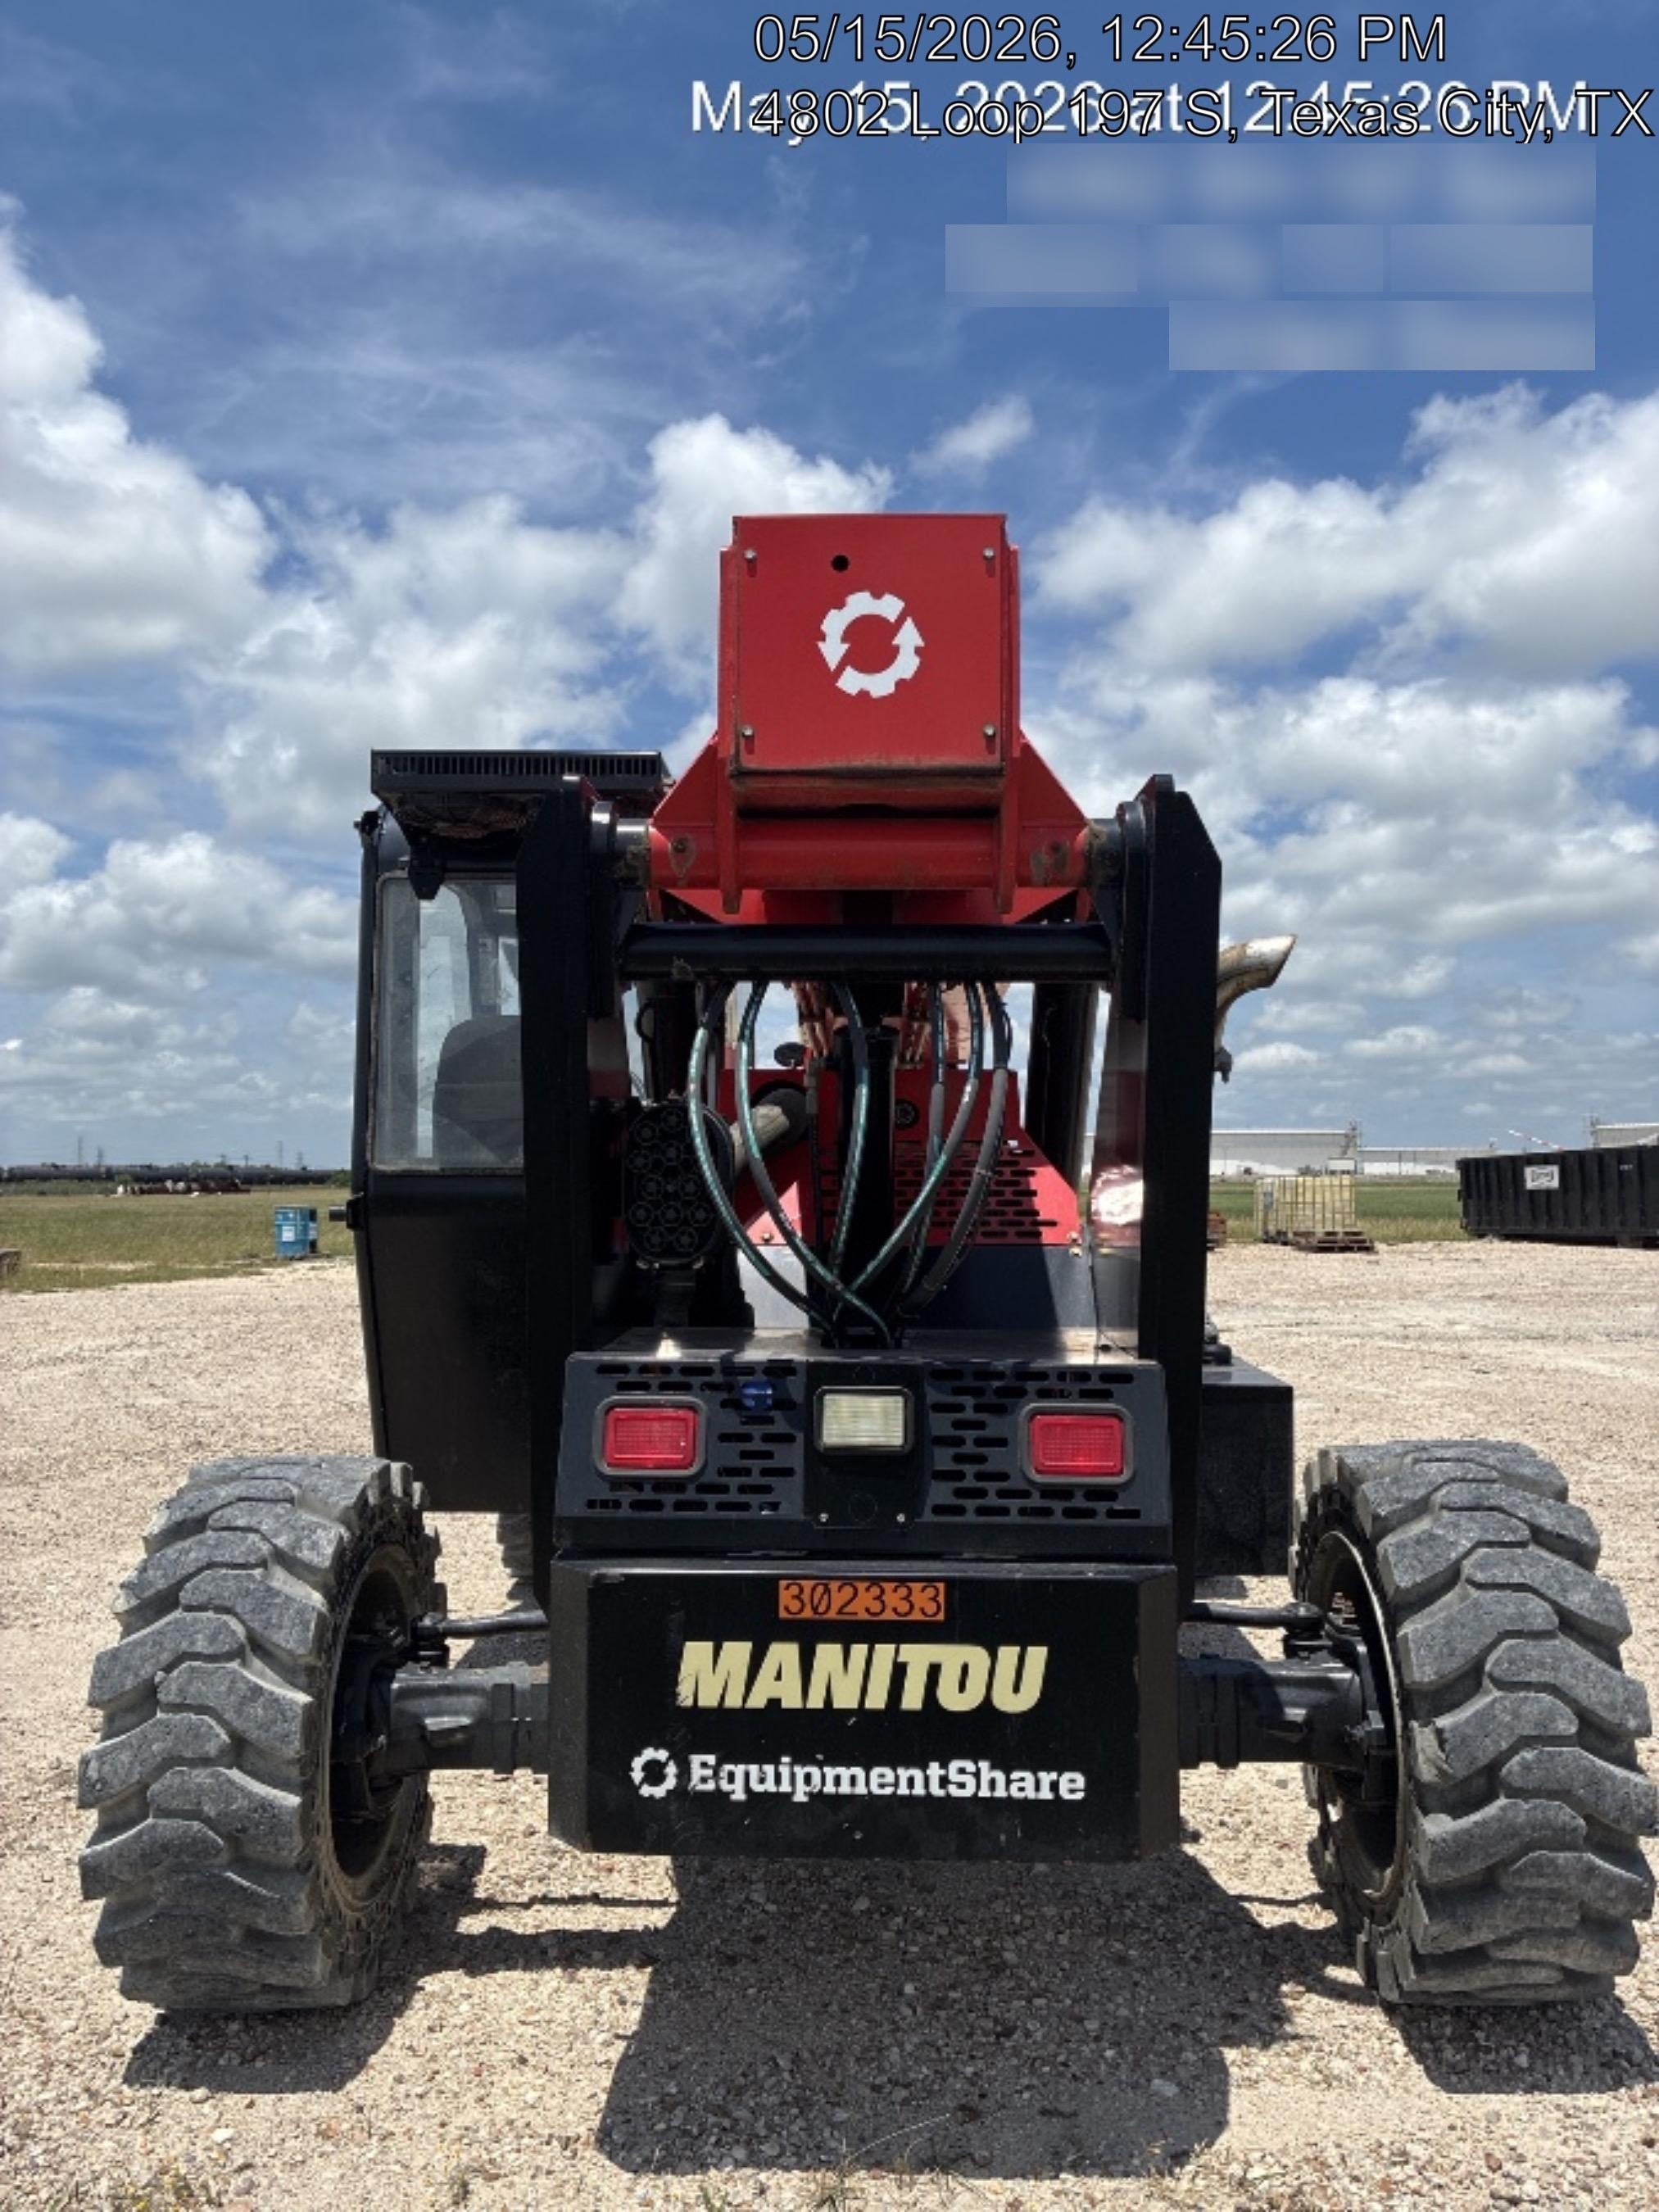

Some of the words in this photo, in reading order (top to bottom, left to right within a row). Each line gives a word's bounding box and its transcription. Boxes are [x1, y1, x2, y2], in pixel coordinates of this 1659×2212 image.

[782, 1582, 942, 1618] 302333
[677, 1641, 1049, 1714] MANITOU
[687, 1754, 1086, 1802] EquipmentShare
